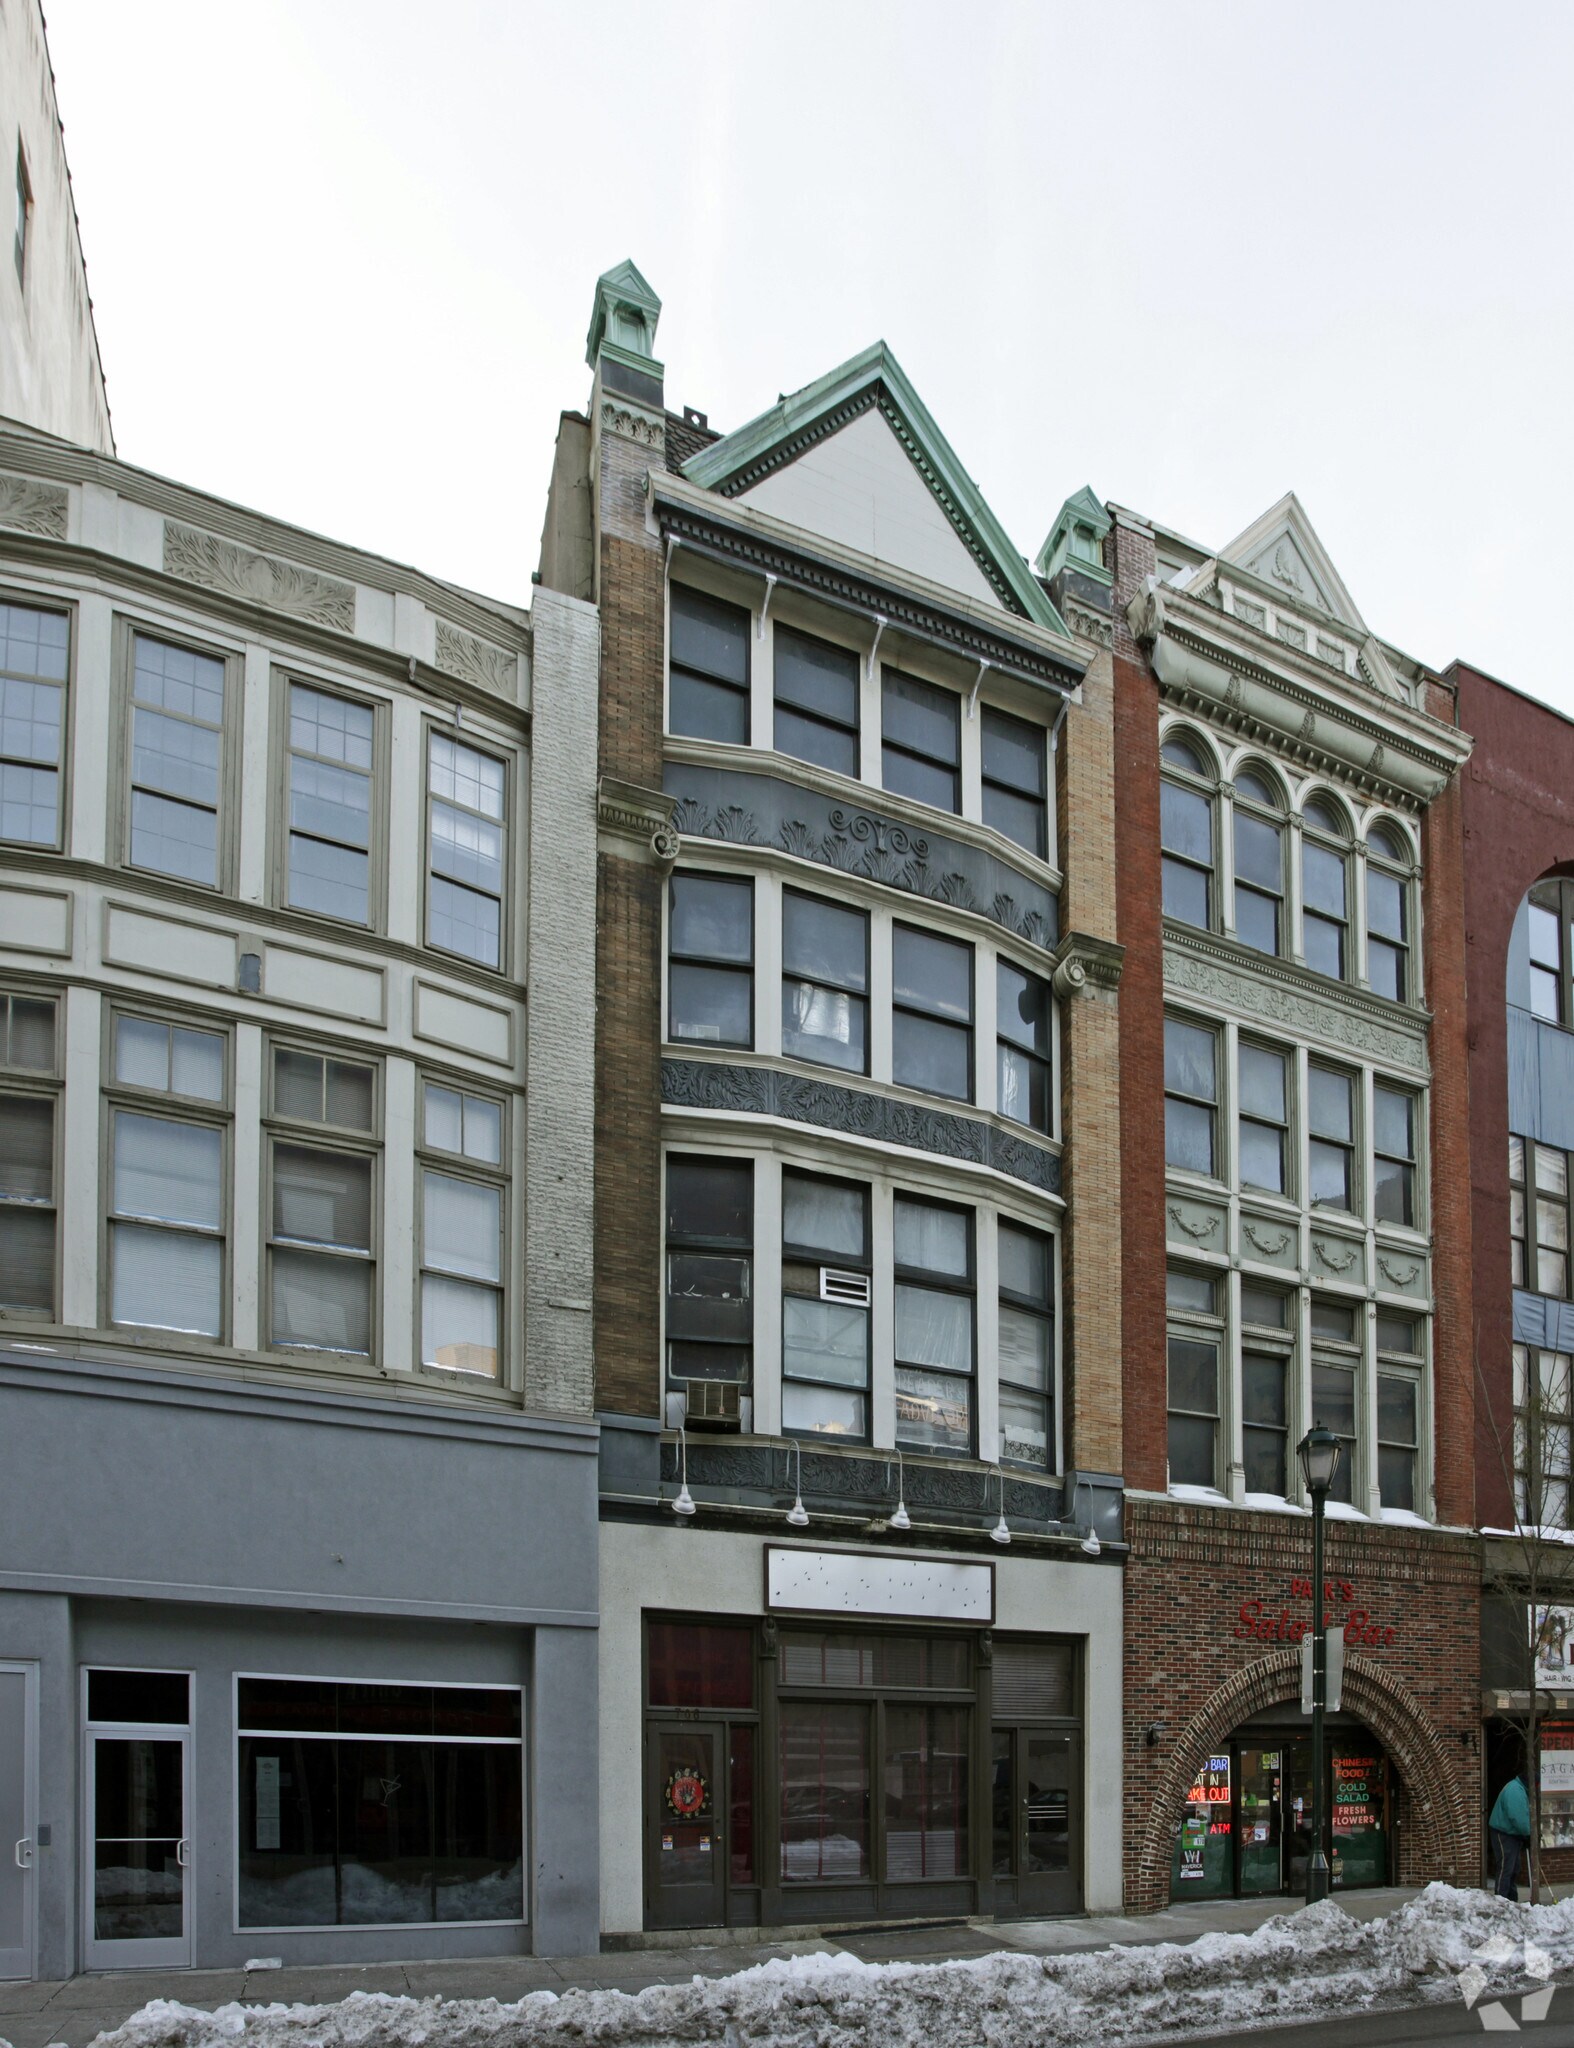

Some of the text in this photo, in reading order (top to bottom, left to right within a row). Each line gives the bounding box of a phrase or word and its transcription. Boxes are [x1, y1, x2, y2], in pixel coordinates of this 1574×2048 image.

[1291, 1579, 1354, 1601] PAK'S
[1343, 1610, 1397, 1645] Bar
[1210, 1758, 1228, 1771] BAR
[1332, 1758, 1375, 1767] CHINESE
[1335, 1769, 1364, 1778] FOOD
[1193, 1773, 1219, 1786] AT IN
[1339, 1782, 1367, 1792] COLD
[1187, 1787, 1229, 1802] AKE OUT
[1336, 1793, 1370, 1803] SALAD
[1338, 1805, 1367, 1815] FRESH
[1332, 1815, 1375, 1826] FLOWERS
[1209, 1823, 1231, 1834] ATM
